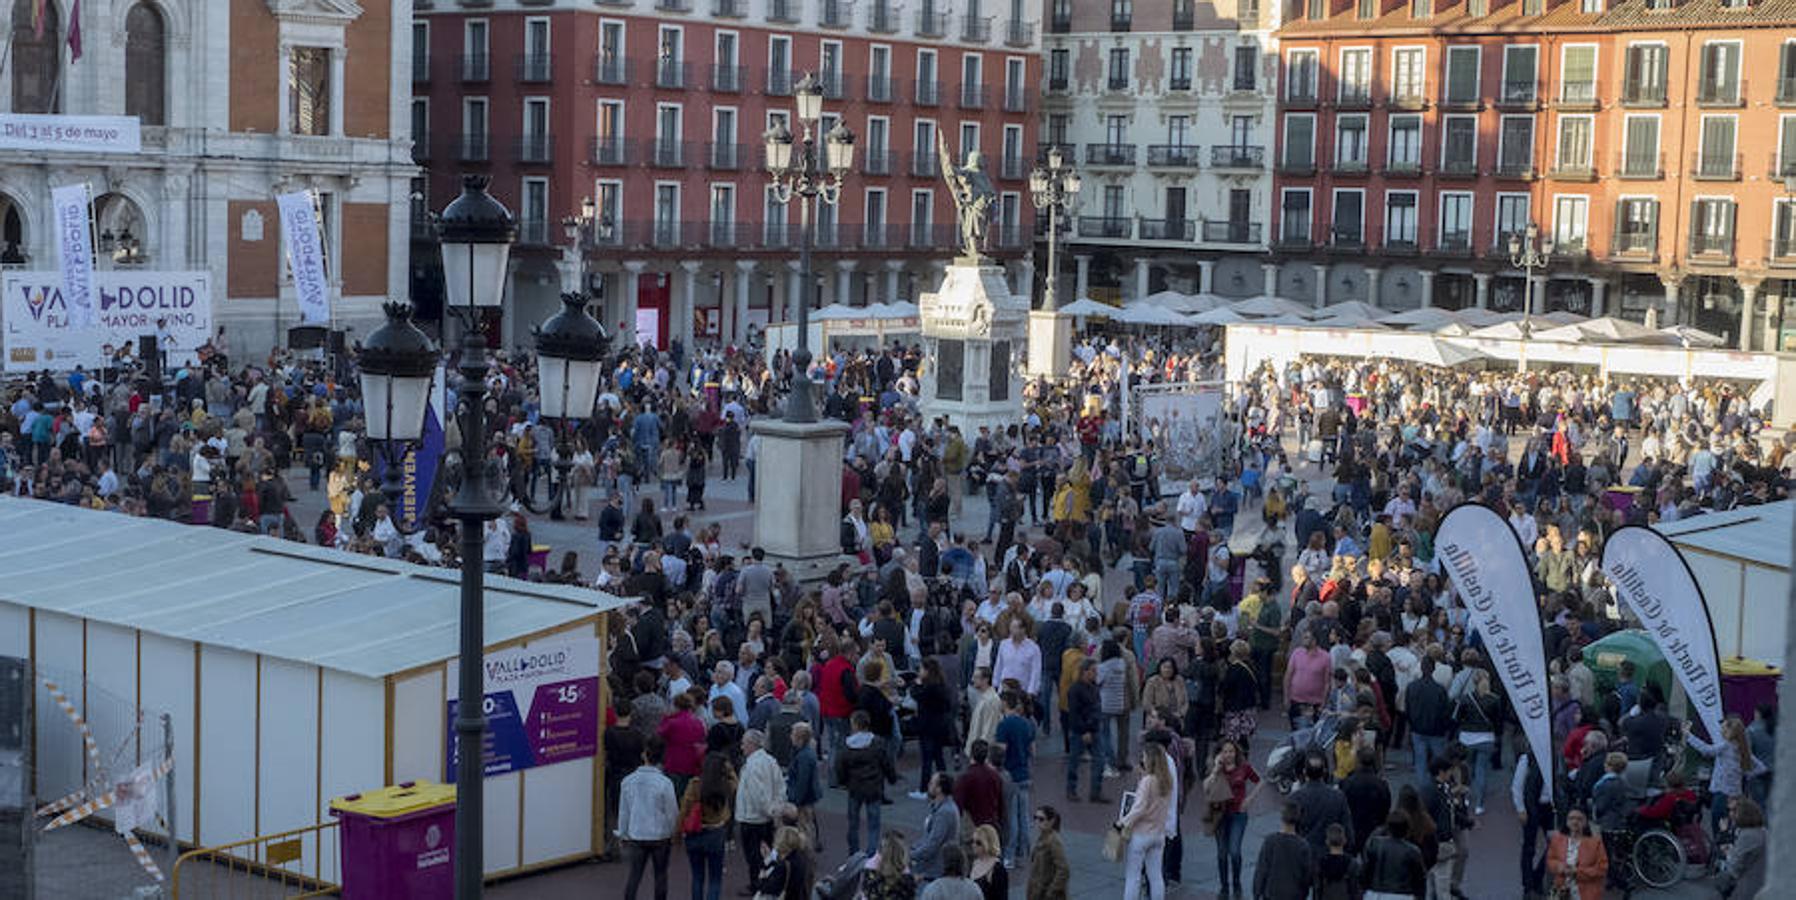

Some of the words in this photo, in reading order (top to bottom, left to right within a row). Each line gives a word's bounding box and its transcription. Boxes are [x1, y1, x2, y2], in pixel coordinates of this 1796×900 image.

[4, 123, 26, 138] Del
[30, 127, 38, 139] 3
[40, 125, 53, 137] al
[55, 127, 63, 140] 5
[65, 126, 81, 138] de
[83, 127, 118, 140] mayo
